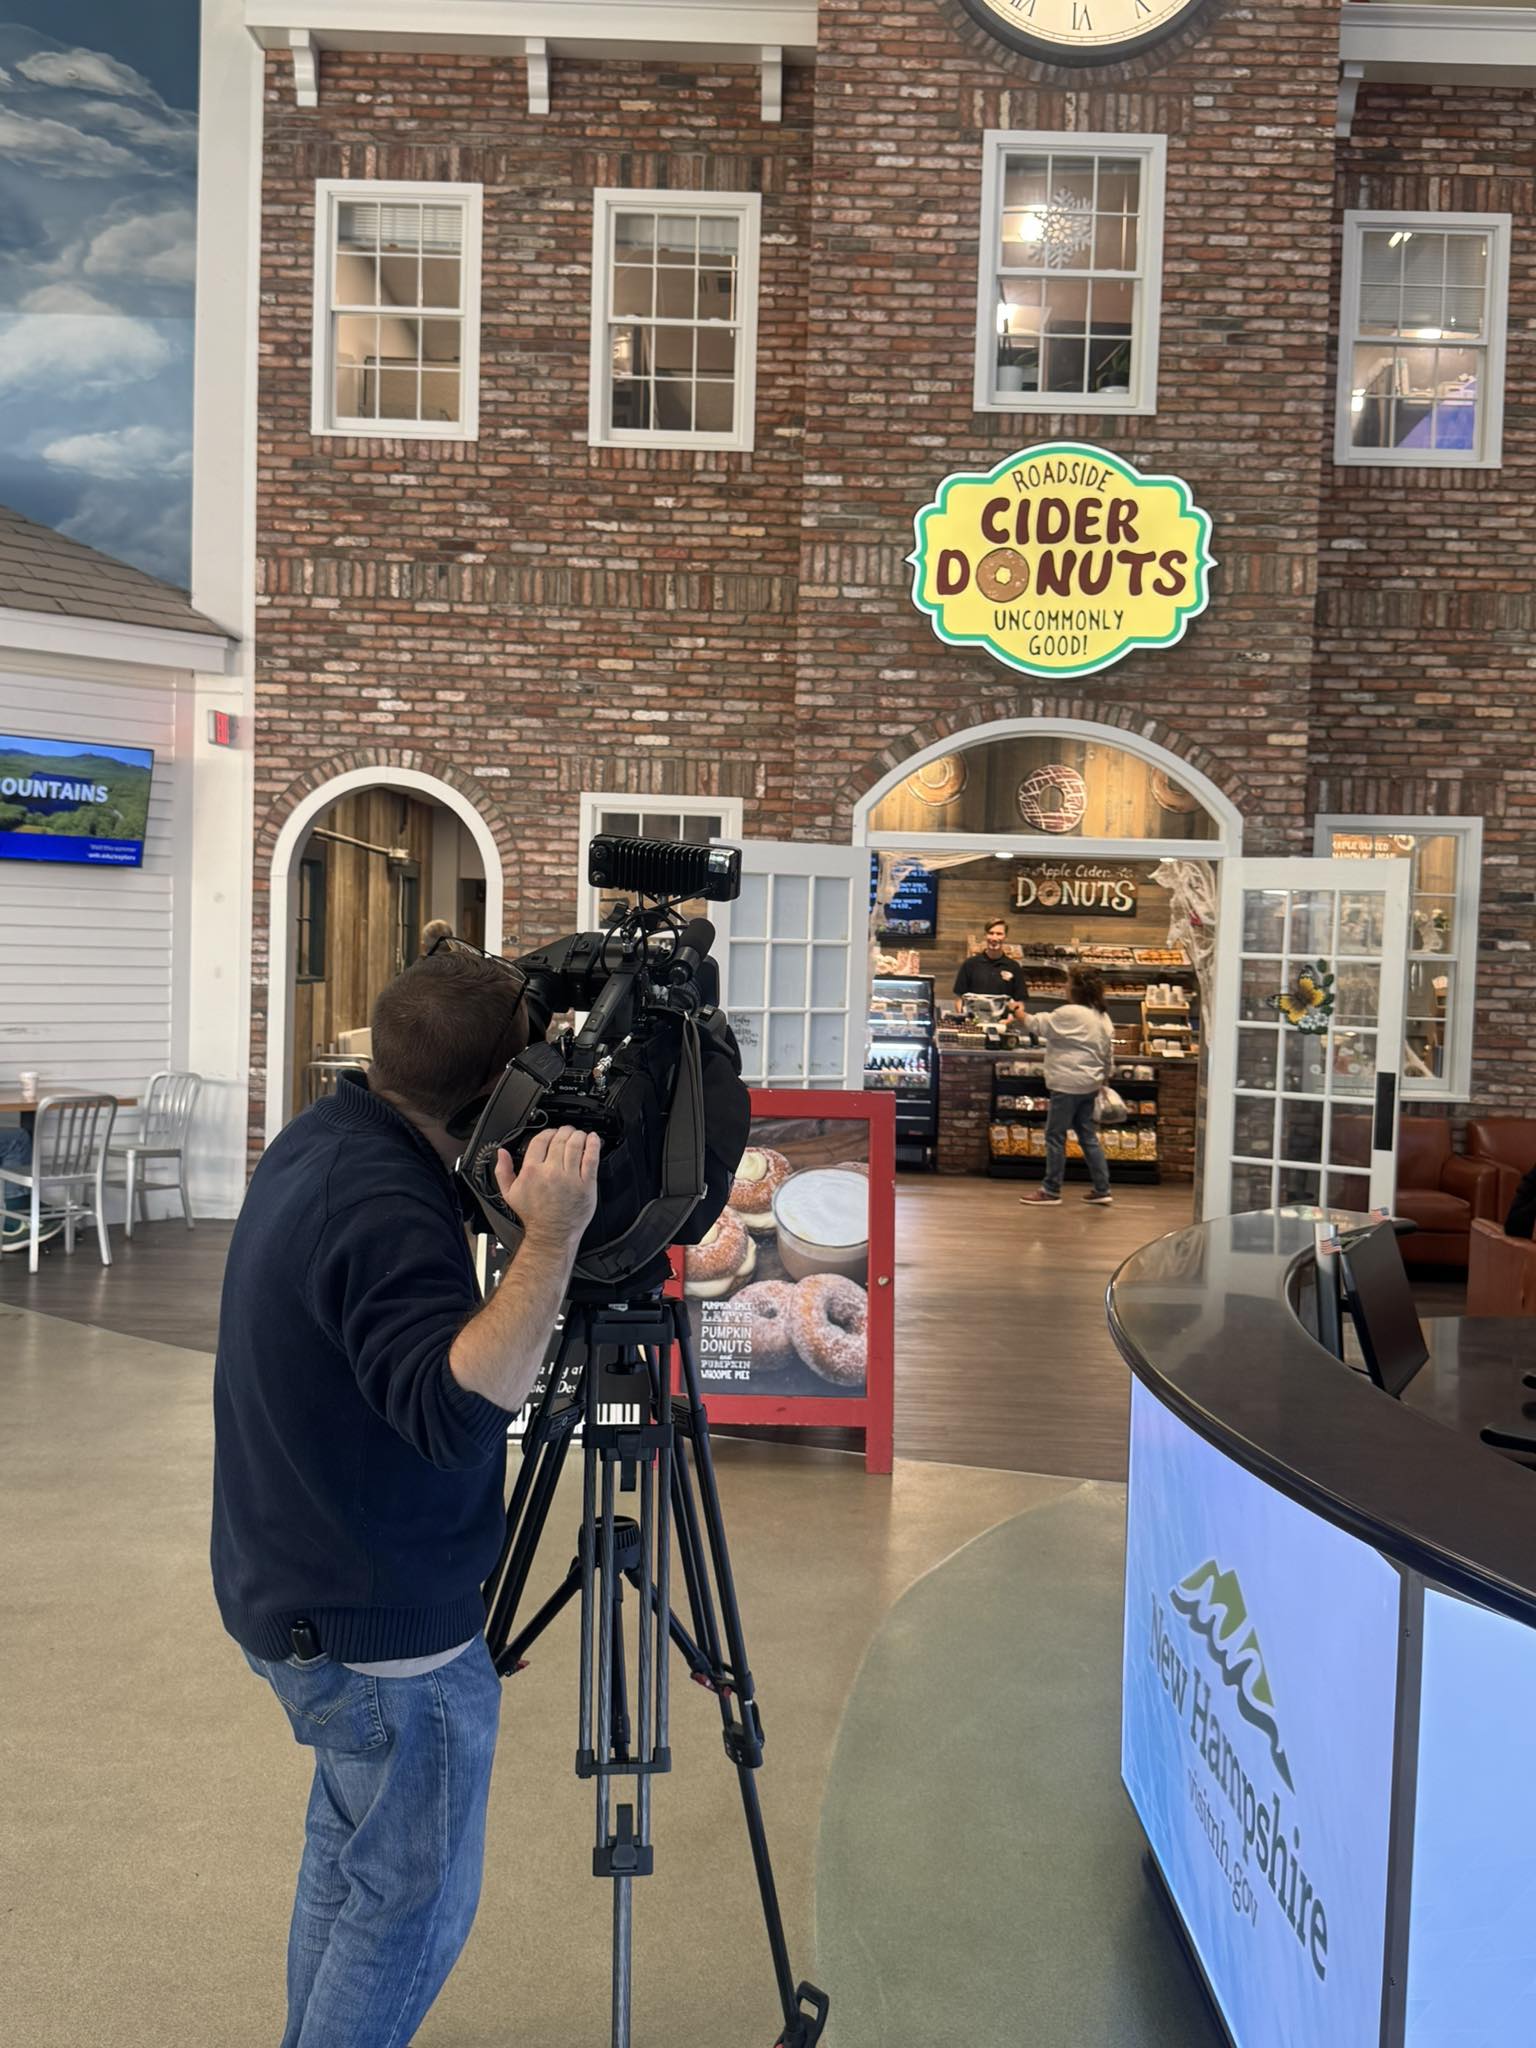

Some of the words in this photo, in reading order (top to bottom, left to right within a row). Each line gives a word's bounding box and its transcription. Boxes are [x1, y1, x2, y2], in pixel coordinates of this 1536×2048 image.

[1012, 461, 1114, 493] ROADSIDE
[981, 497, 1139, 545] CIDER
[936, 547, 1187, 603] DONUTS
[994, 609, 1124, 631] UNCOMMONLY
[1028, 634, 1088, 656] GOOD!
[0, 776, 109, 803] OUNTAINS
[1032, 862, 1072, 880] Apple
[1075, 864, 1112, 878] Cider
[1015, 876, 1137, 912] DONUTS
[701, 1310, 753, 1322] LATTE
[701, 1325, 752, 1339] PUMPKIN
[700, 1338, 753, 1353] DONUTS
[701, 1359, 751, 1370] PUMPKIN
[1149, 1591, 1188, 1717] New
[1190, 1665, 1329, 1981] Hampshire
[1187, 1767, 1259, 1928] visitnh.gov
